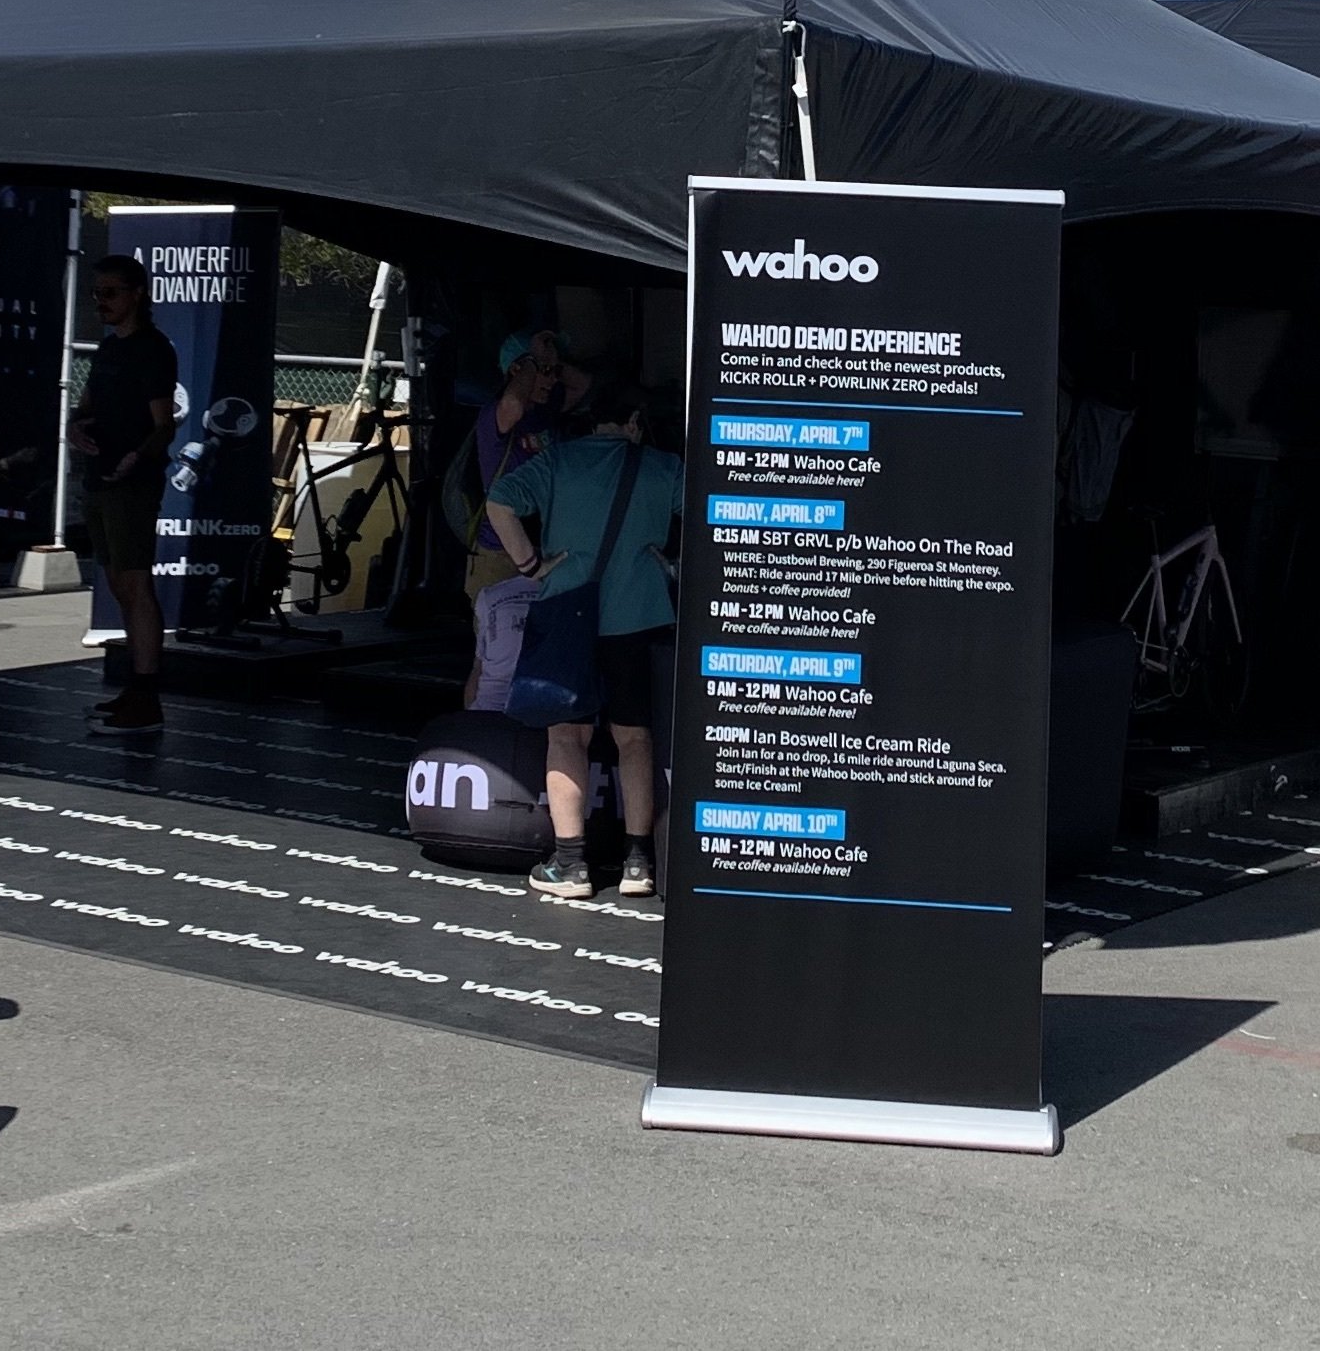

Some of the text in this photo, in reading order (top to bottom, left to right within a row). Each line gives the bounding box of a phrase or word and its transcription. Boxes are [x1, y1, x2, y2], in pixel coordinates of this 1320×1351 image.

[151, 245, 256, 274] POWERFUL
[721, 238, 879, 283] wahoo
[151, 276, 248, 304] DVANTAGE
[721, 322, 962, 357] WAHOO DEMO EXPERIENCE
[720, 351, 1006, 380] Come in and check out the newest products,
[720, 370, 761, 385] KICKR
[762, 372, 807, 387] ROLLR
[819, 374, 890, 391] POWRLINK
[891, 378, 928, 393] ZERO
[930, 380, 978, 396] pedals!
[718, 421, 797, 444] THURSDAY,
[798, 425, 841, 445] APRIL
[793, 454, 846, 471] Wahoo
[847, 456, 882, 473] Cafe
[727, 470, 865, 487] Free coffee available here!
[714, 501, 768, 523] FRIDAY,
[770, 504, 812, 524] APRIL
[155, 518, 223, 536] RLINK
[713, 527, 1013, 557] 8:15 AM SBT GRVL p/b Wahoo On The Road
[150, 556, 220, 576] wahoo
[723, 551, 1001, 578] WHERE: Dustbowl Brewing, 290 Figueroa St Monterey.
[722, 581, 760, 594] Donuts
[768, 583, 801, 596] coffee
[800, 585, 852, 599] provided!
[723, 566, 1015, 593] WHAT: Ride around 17 Mile Drive before hitting the expo.
[708, 652, 787, 676] SATURDAY,
[789, 657, 831, 677] APRIL
[705, 725, 951, 755] 2:00PM Ian Boswell Ice Cream Ride
[407, 759, 489, 811] an
[702, 808, 761, 830] SUNDAY
[763, 812, 805, 833] APRIL
[59, 808, 528, 896] wahoo wahoo wahoo wahoo
[173, 871, 562, 951] wahoo wahoo wahoo
[49, 897, 603, 1016] wahoo wahoo wahoo wahoo
